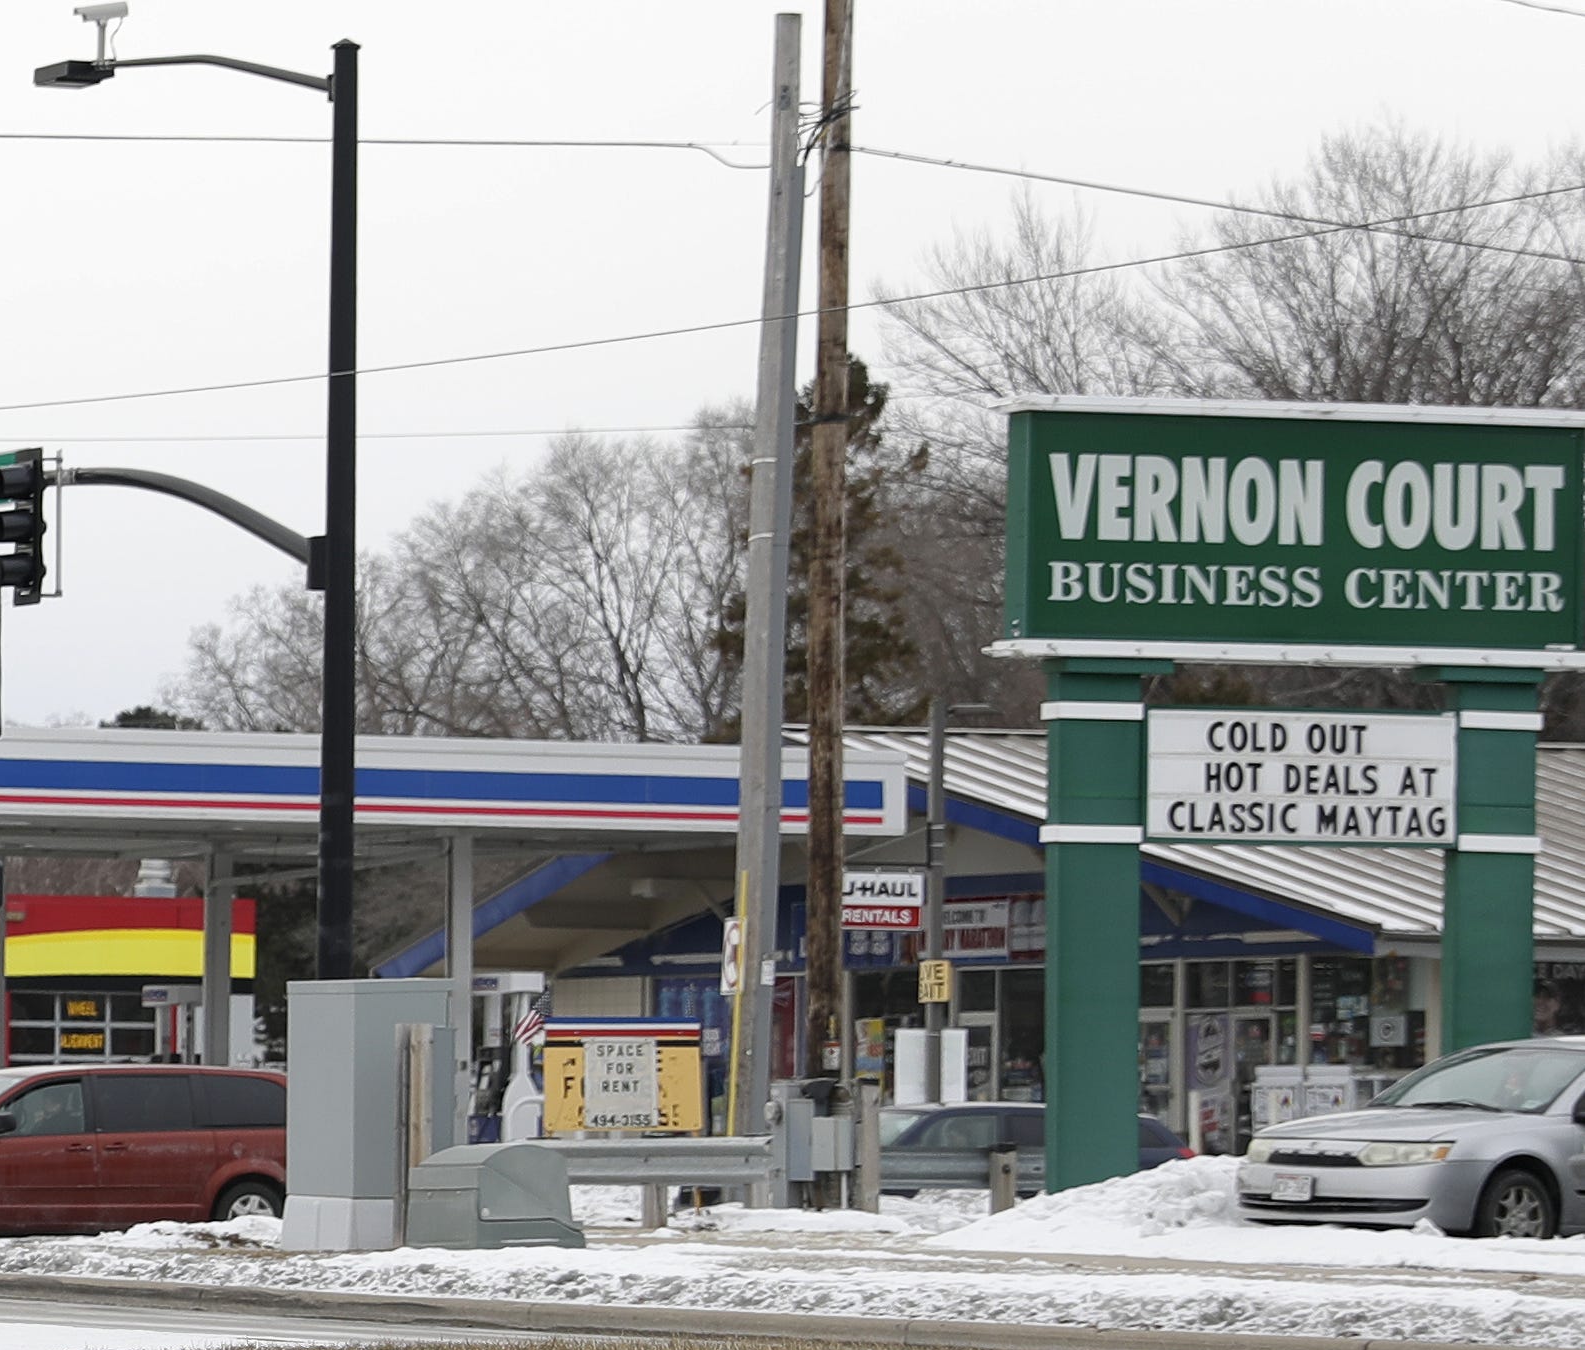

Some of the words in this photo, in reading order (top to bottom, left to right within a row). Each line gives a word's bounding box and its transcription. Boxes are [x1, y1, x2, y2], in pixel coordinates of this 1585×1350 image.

[1048, 452, 1324, 546] VERNON
[1345, 459, 1565, 551] COURT
[1047, 561, 1322, 608] BUSINESS
[1344, 568, 1565, 612] CENTER
[1206, 721, 1287, 752] COLD
[1306, 723, 1367, 755] OUT
[1204, 761, 1262, 793] HOT
[1284, 763, 1377, 796] DEALS
[1399, 766, 1437, 798] AT
[1167, 801, 1297, 833] CLASSIC
[1316, 804, 1446, 837] MAYTAG
[841, 908, 912, 924] RENTALS
[596, 1044, 645, 1057] SPACE
[606, 1062, 635, 1075] FOR
[601, 1080, 640, 1093] RENT
